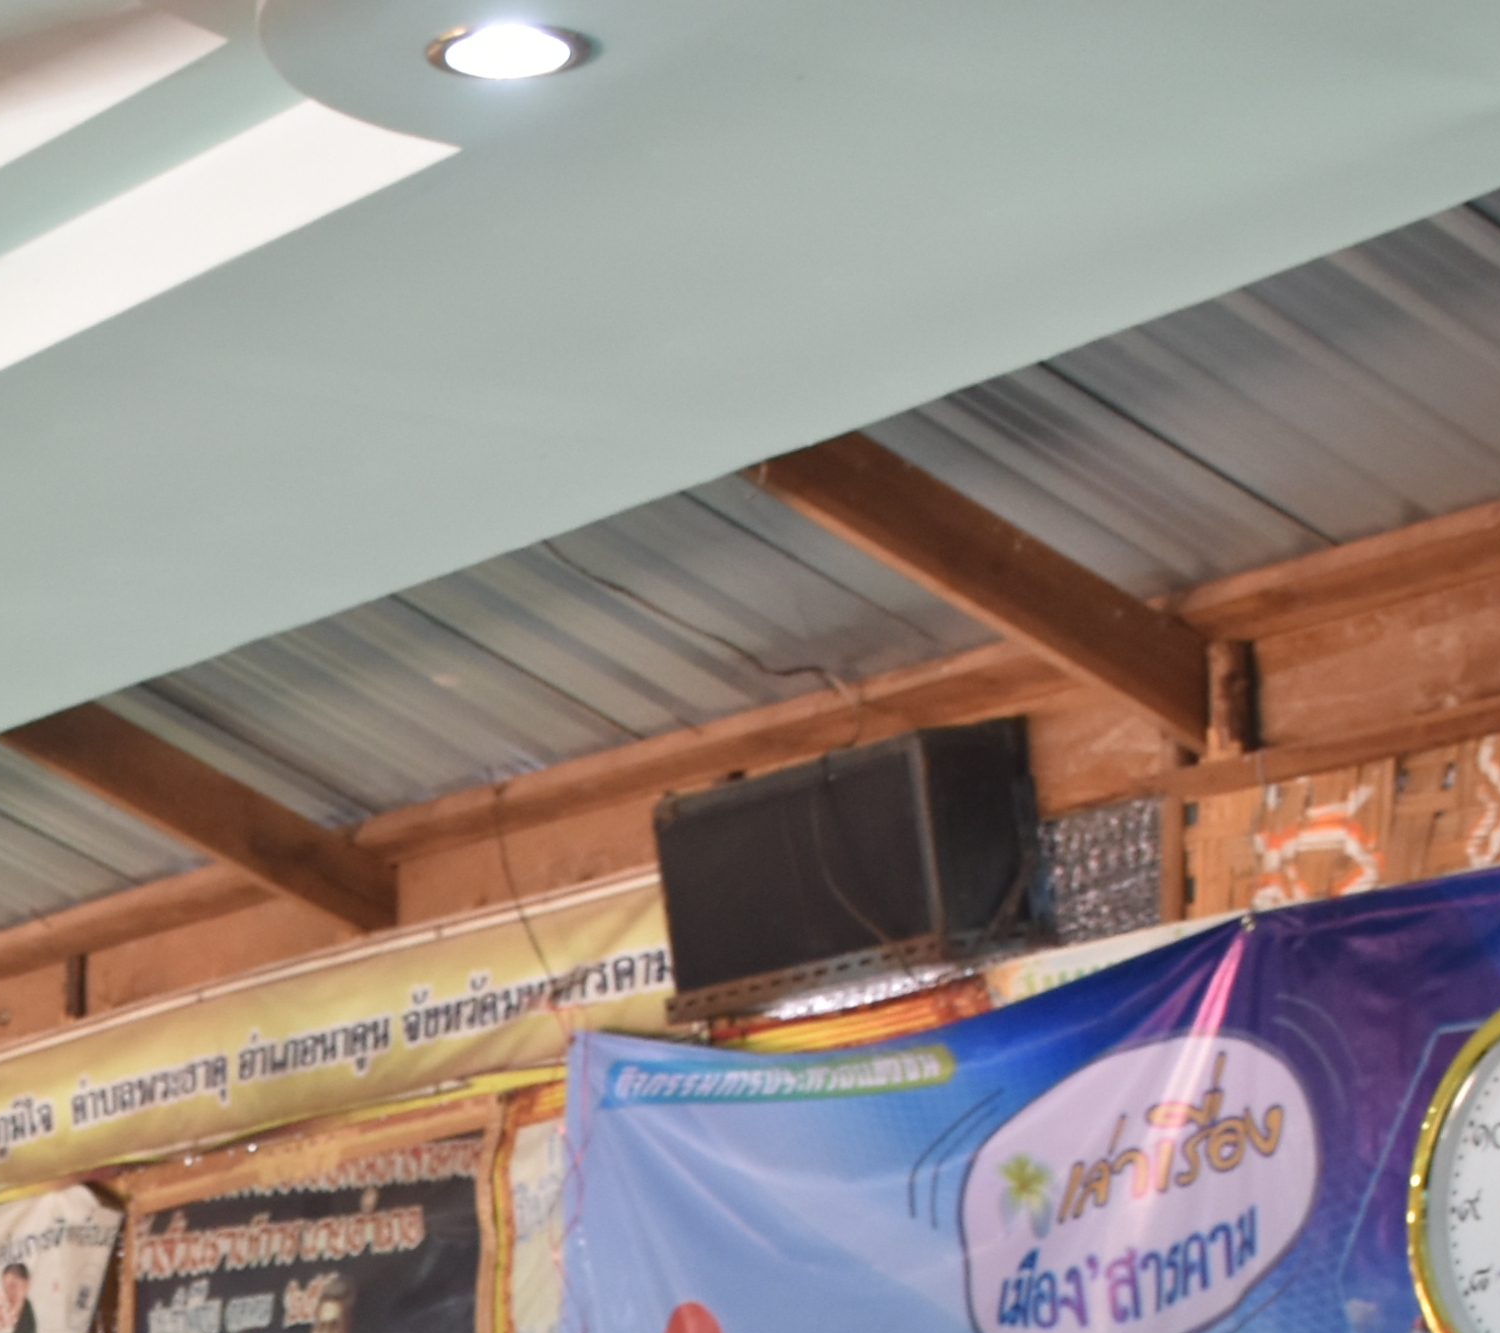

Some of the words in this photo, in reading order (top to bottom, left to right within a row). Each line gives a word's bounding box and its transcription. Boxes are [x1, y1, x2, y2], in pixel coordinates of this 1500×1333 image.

[73, 1055, 229, 1127] ตำบลพระธาตุ
[238, 1017, 391, 1080] อำเภอนาดูน
[1056, 1051, 1284, 1224] เล่าเรื่อง
